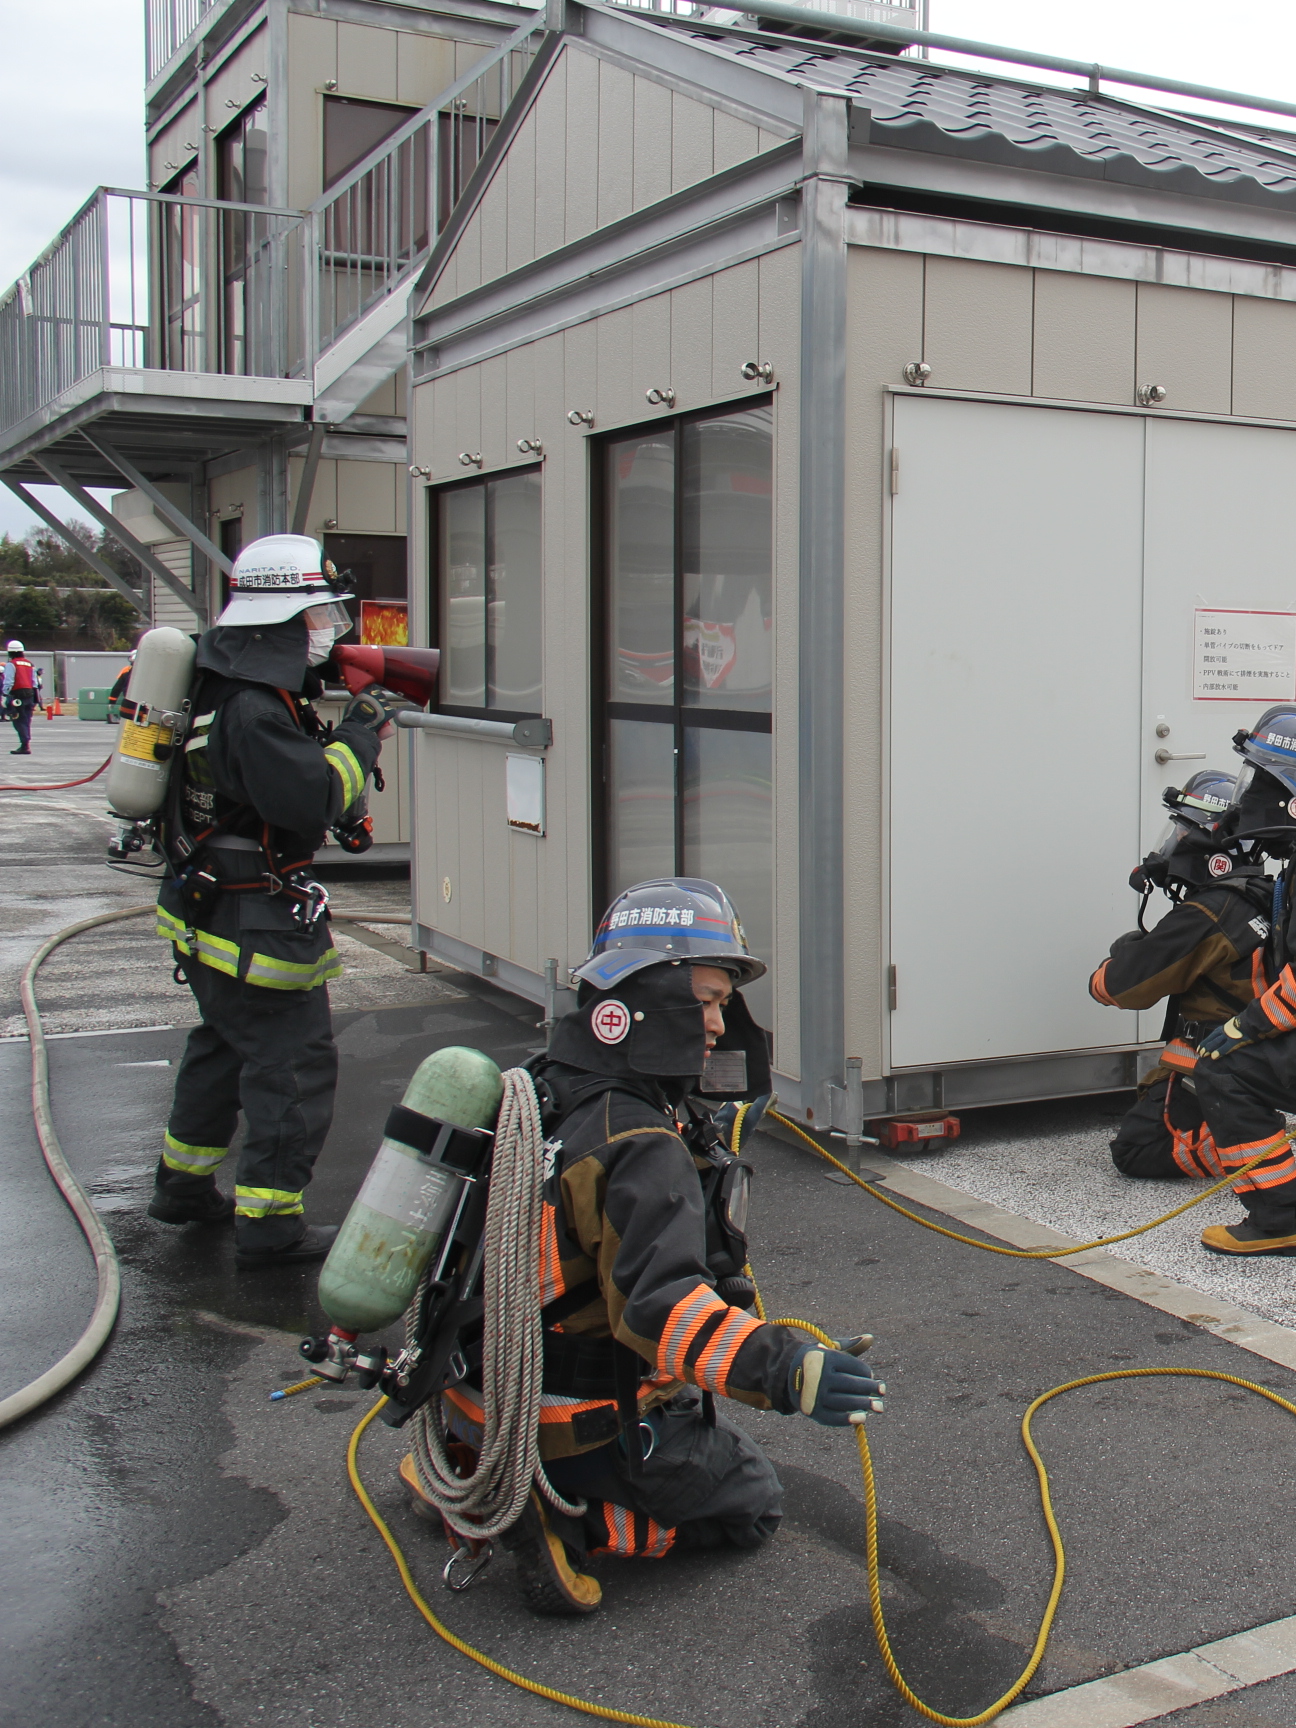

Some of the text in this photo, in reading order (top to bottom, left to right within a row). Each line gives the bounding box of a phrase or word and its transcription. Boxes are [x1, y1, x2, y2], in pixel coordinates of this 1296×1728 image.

[238, 566, 276, 574] NARITA
[238, 572, 300, 588] 成田市消防本部
[1203, 655, 1228, 664] 開放可能
[608, 906, 694, 931] 野田市消防本部
[600, 1010, 622, 1034] 中
